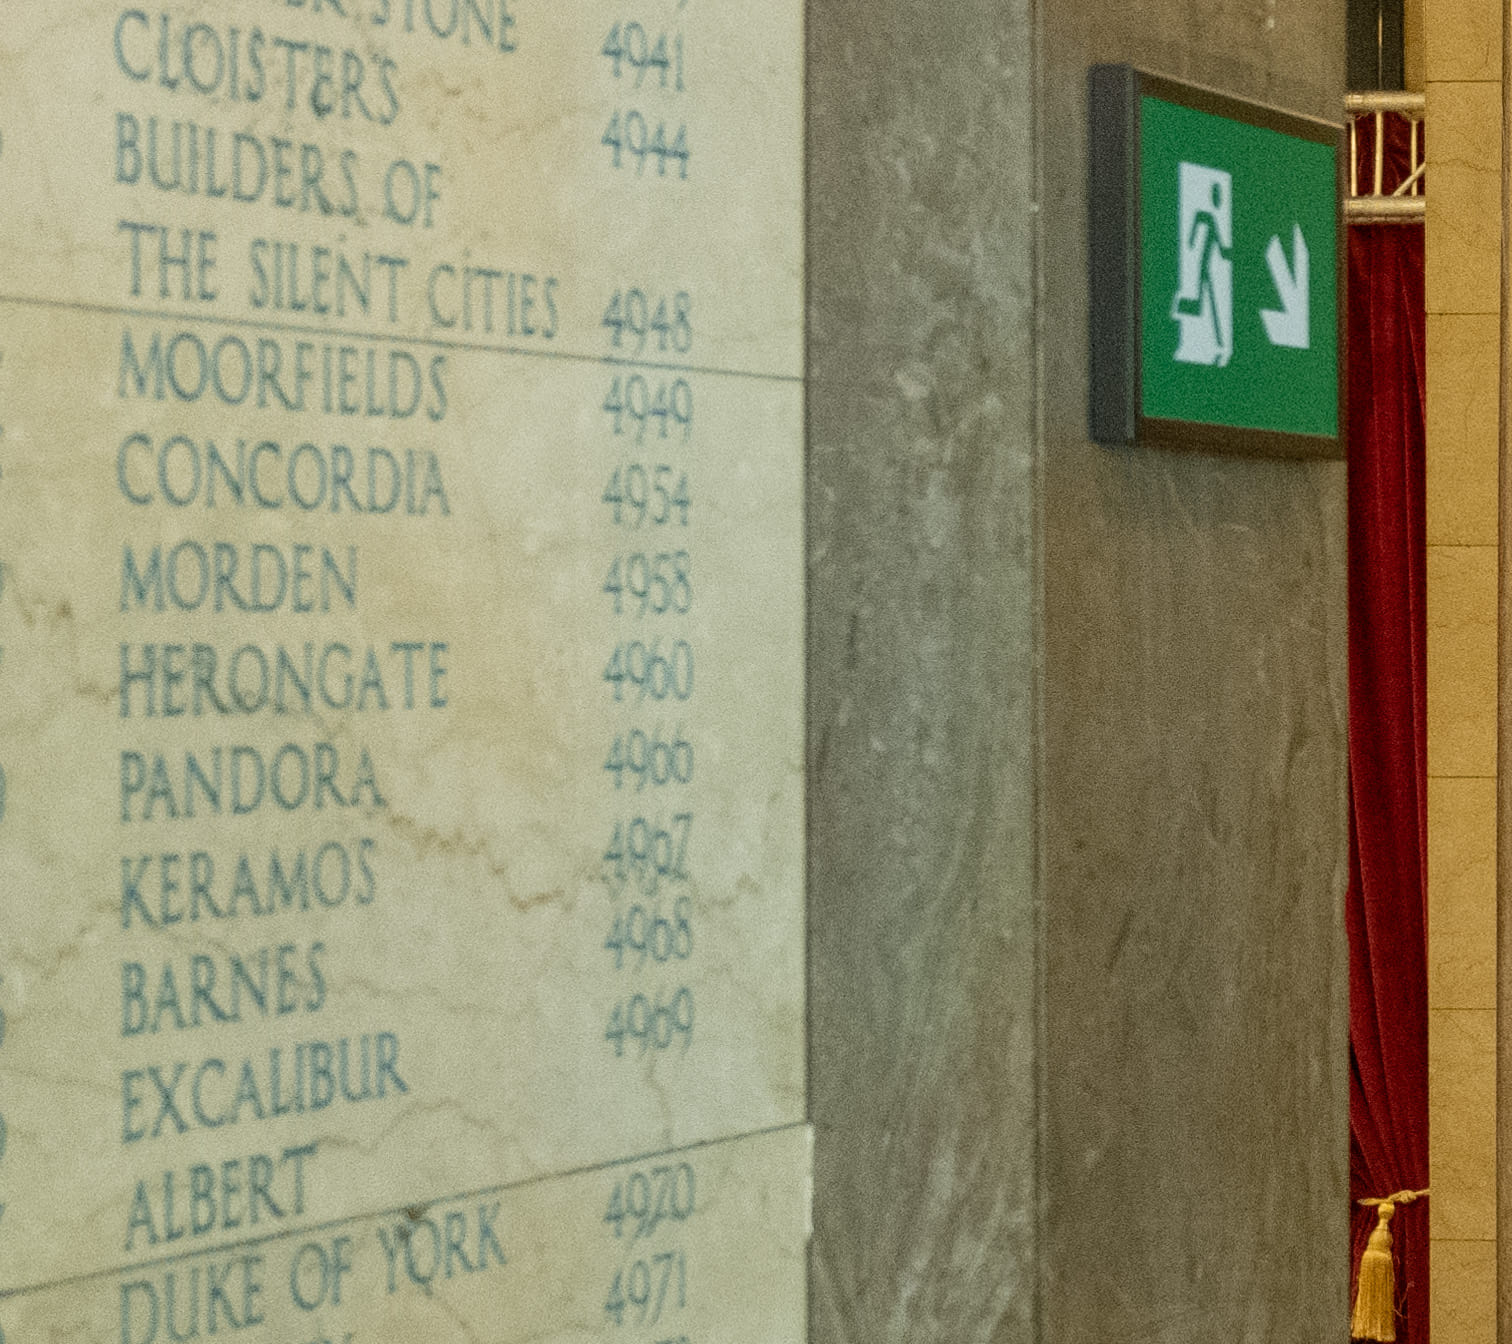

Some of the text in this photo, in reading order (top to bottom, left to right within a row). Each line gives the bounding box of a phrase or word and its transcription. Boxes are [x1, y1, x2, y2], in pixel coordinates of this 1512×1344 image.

[114, 9, 690, 180] CLOISTERS 4944
[603, 20, 686, 93] 4941
[116, 115, 442, 228] BUILDERS OF
[118, 219, 694, 353] THE SILENT CITIES 4948
[120, 332, 694, 444] MOORFIELDS 4949
[117, 432, 693, 529] CONCORDIA 4954
[120, 541, 694, 620] MORDEN 4958
[120, 640, 695, 719] HERONGATE 4960
[120, 729, 695, 823] PANDORA 4966
[121, 816, 694, 929] KERAMOS 4967
[121, 901, 694, 1036] BARNES 4968
[121, 988, 696, 1146] EXCALIBUR 4969
[125, 1144, 320, 1251] ALBERT
[290, 1237, 353, 1311] OF
[378, 1202, 506, 1295] YORK
[606, 1162, 696, 1243] 4970
[606, 1253, 687, 1327] 4971
